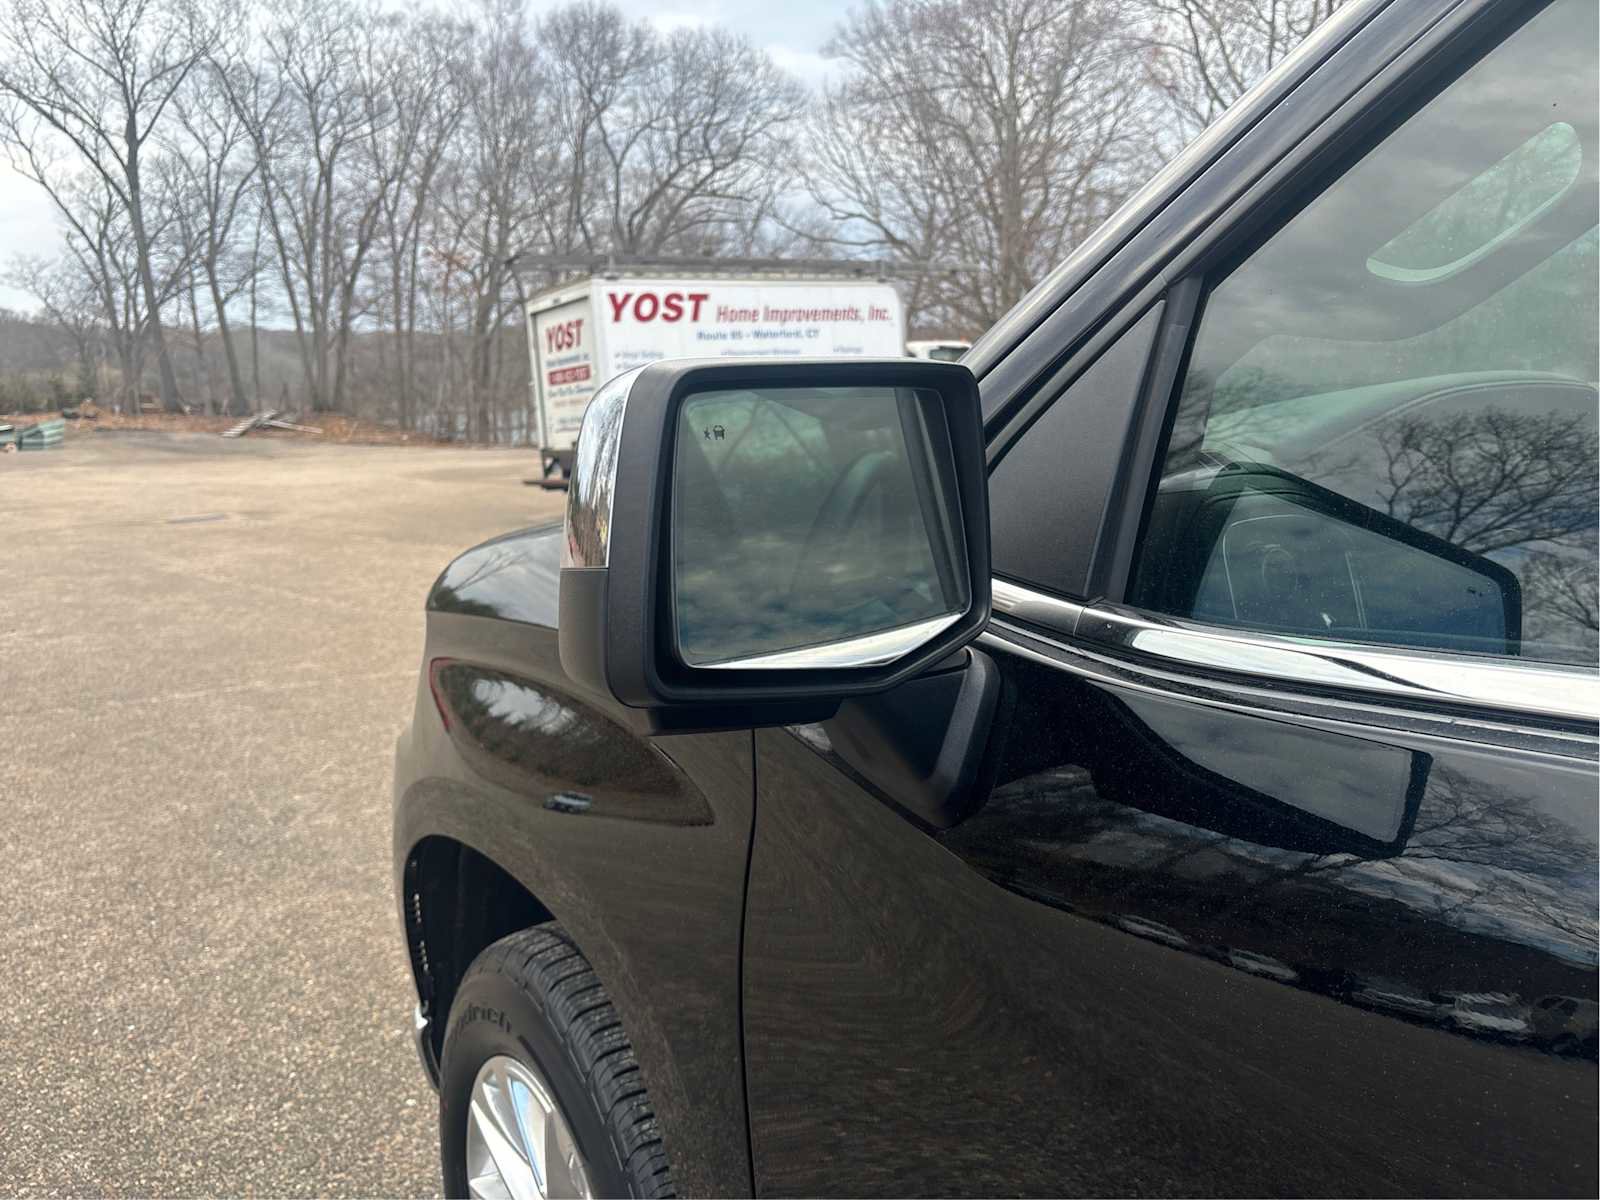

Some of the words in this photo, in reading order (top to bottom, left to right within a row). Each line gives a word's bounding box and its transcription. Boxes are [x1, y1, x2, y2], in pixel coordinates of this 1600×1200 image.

[608, 292, 709, 323] YOST
[716, 306, 759, 323] Home
[763, 304, 865, 325] Improvements,
[868, 304, 893, 322] Inc.
[545, 319, 584, 354] YOST
[697, 330, 728, 341] Route
